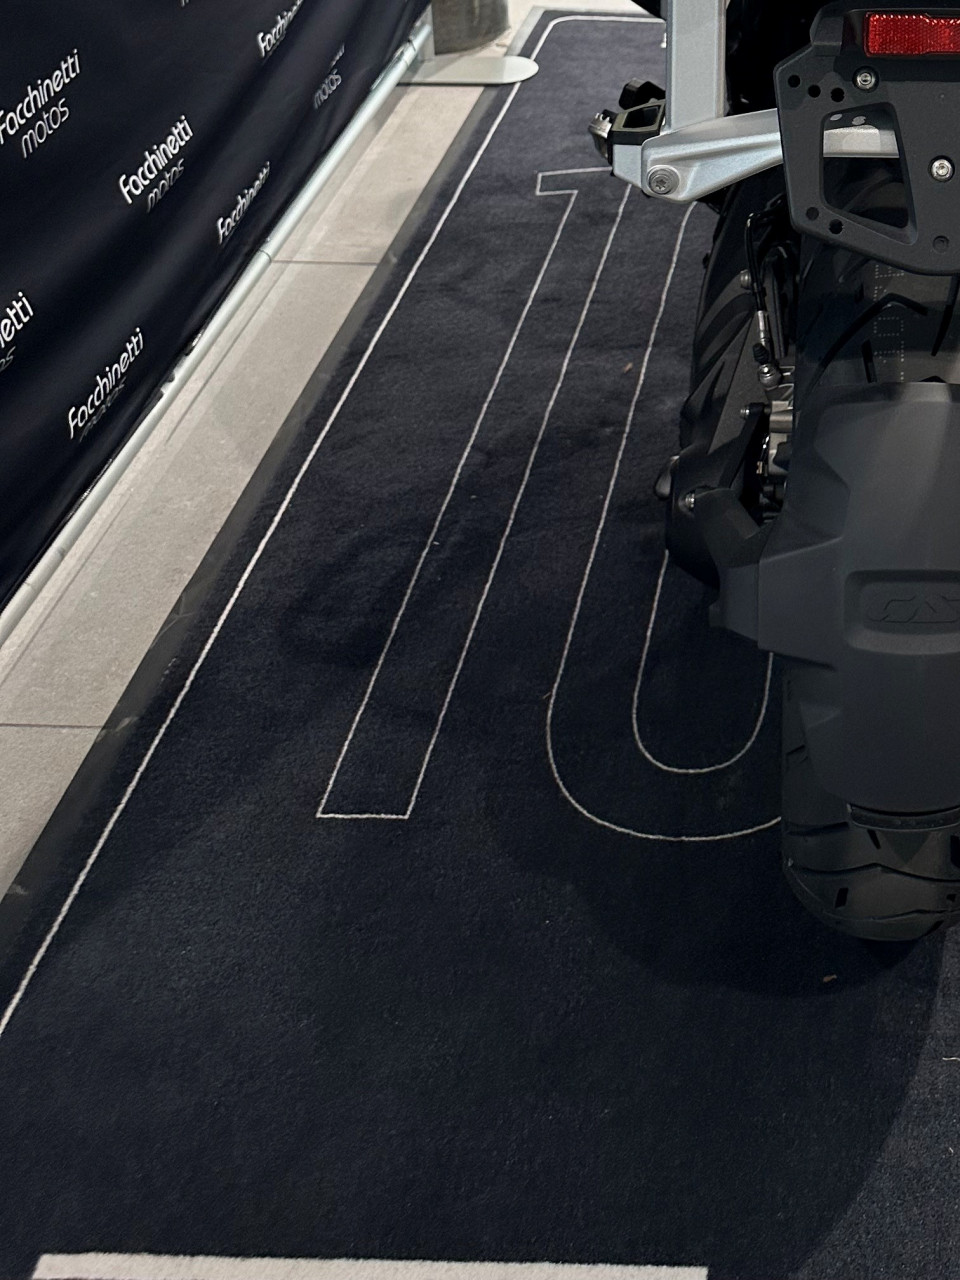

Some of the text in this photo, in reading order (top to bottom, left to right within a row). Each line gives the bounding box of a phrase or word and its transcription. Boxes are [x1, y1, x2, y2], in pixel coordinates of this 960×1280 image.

[21, 97, 70, 158] motos
[119, 115, 194, 204] Facchinetti
[68, 327, 144, 440] Facchinetti
